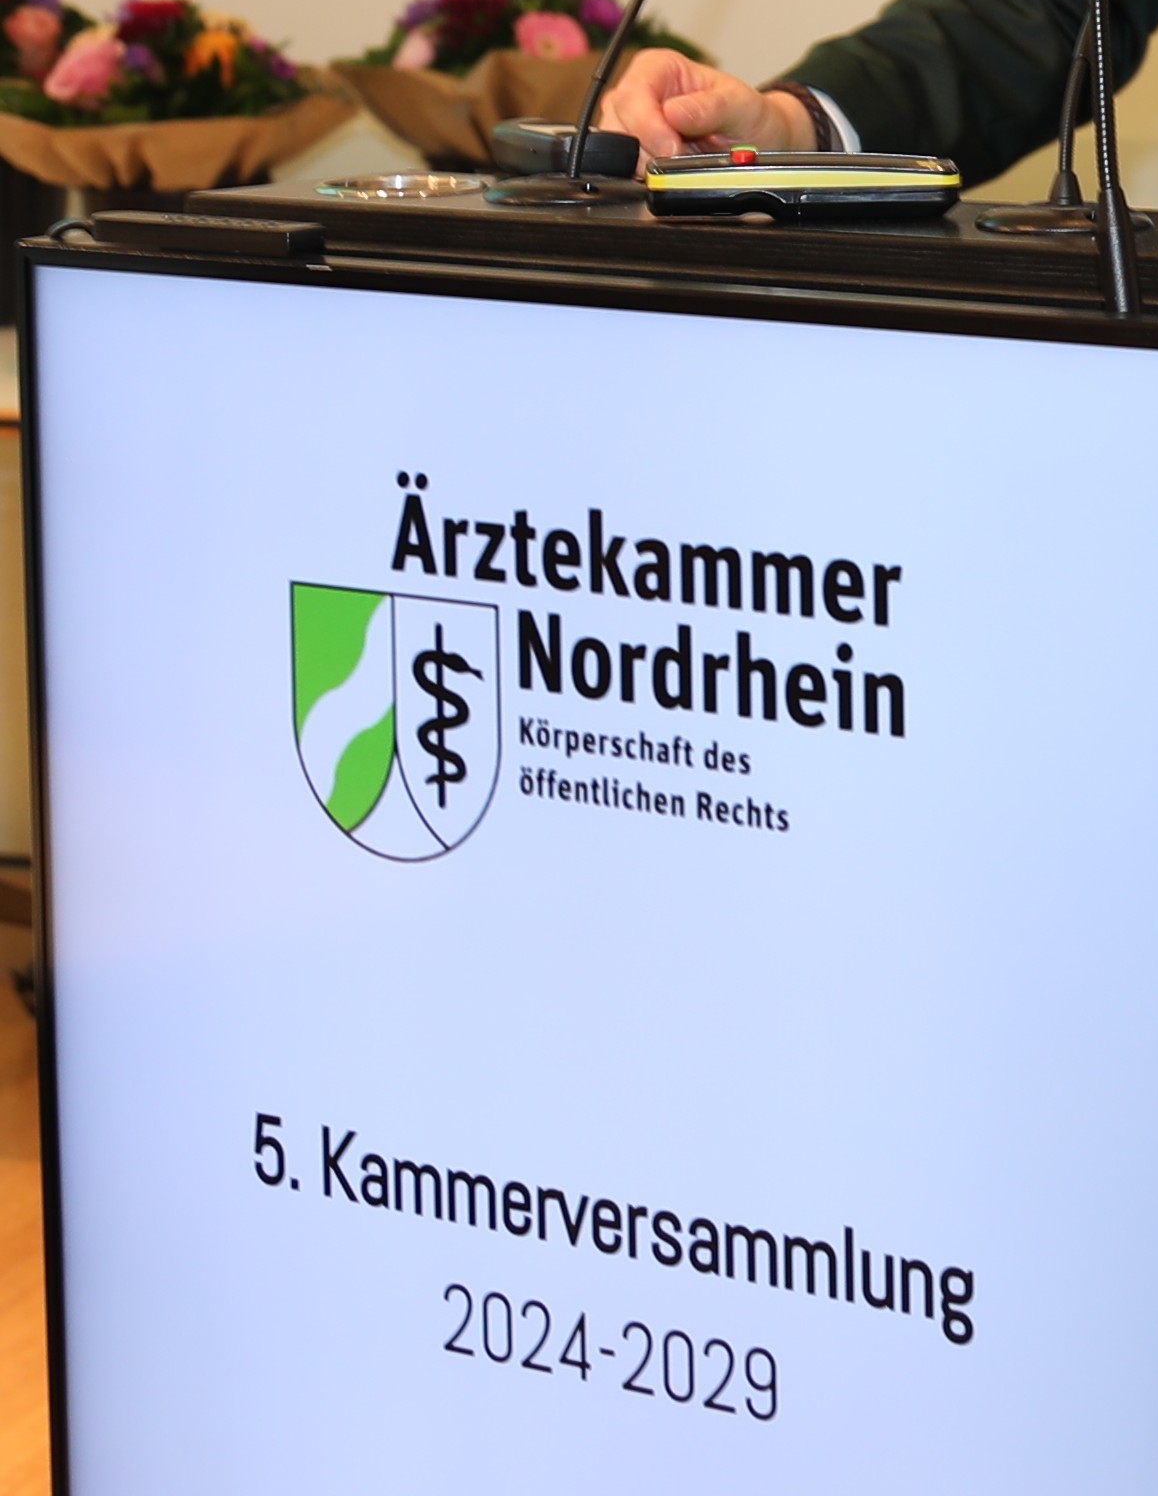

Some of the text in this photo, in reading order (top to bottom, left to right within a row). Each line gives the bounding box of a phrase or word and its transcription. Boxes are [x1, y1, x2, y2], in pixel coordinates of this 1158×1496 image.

[391, 471, 903, 627] Ärztekammer
[517, 609, 905, 738] Nordrhein
[519, 716, 751, 775] Körperschaft des
[519, 766, 789, 832] öffentlichen Rechts
[254, 1112, 974, 1346] 5. Kammerversammlung
[443, 1283, 778, 1422] 2024-2029
